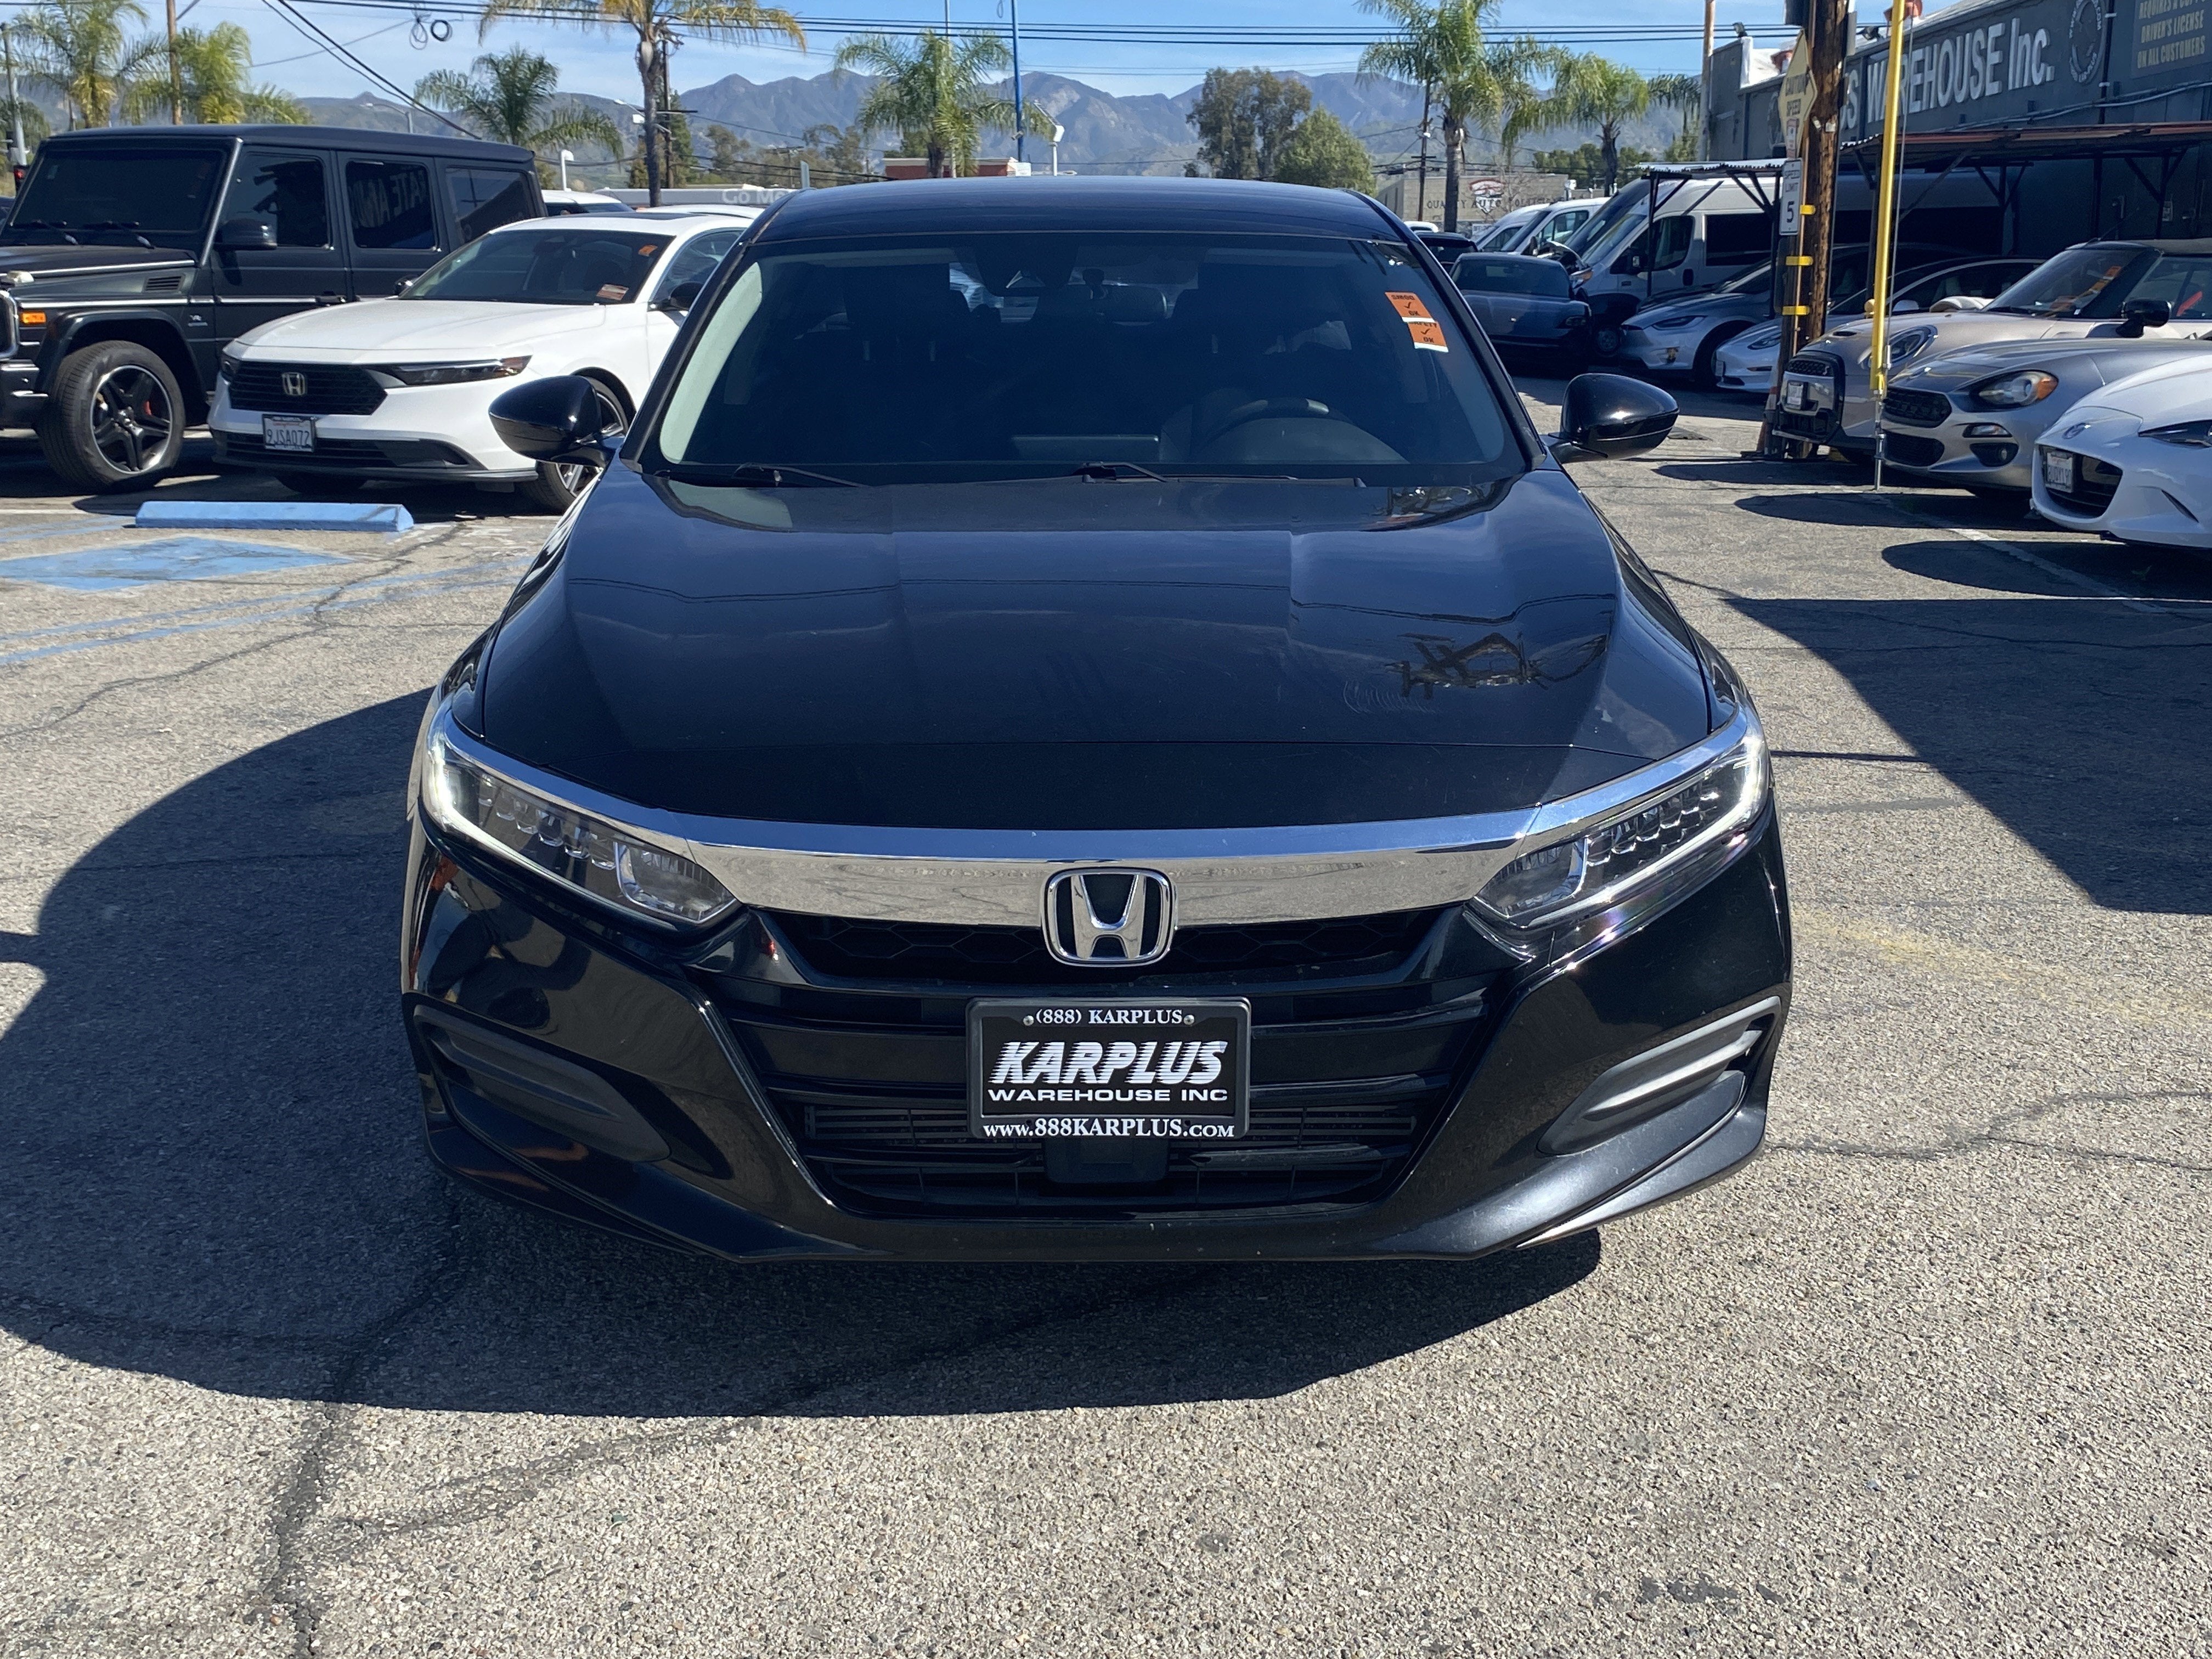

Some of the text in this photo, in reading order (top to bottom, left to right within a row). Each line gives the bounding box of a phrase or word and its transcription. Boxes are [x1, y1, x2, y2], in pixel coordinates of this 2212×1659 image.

[2141, 9, 2205, 43] DRIVER'S LICENSE
[2137, 35, 2206, 69] ON ALL CUSTOMERS
[1867, 22, 2006, 123] WREHOUSE
[2008, 18, 2055, 91] Inc.
[1785, 170, 1800, 179] SPEED
[1785, 182, 1798, 193] LIMIT
[722, 189, 751, 204] Go
[1471, 199, 1501, 208] AUTO
[1786, 201, 1795, 223] 5
[1036, 1009, 1183, 1025] (888) KARPLUS
[988, 1041, 1228, 1085] KARPLUS
[988, 1090, 1228, 1102] WAREHOUSE INC
